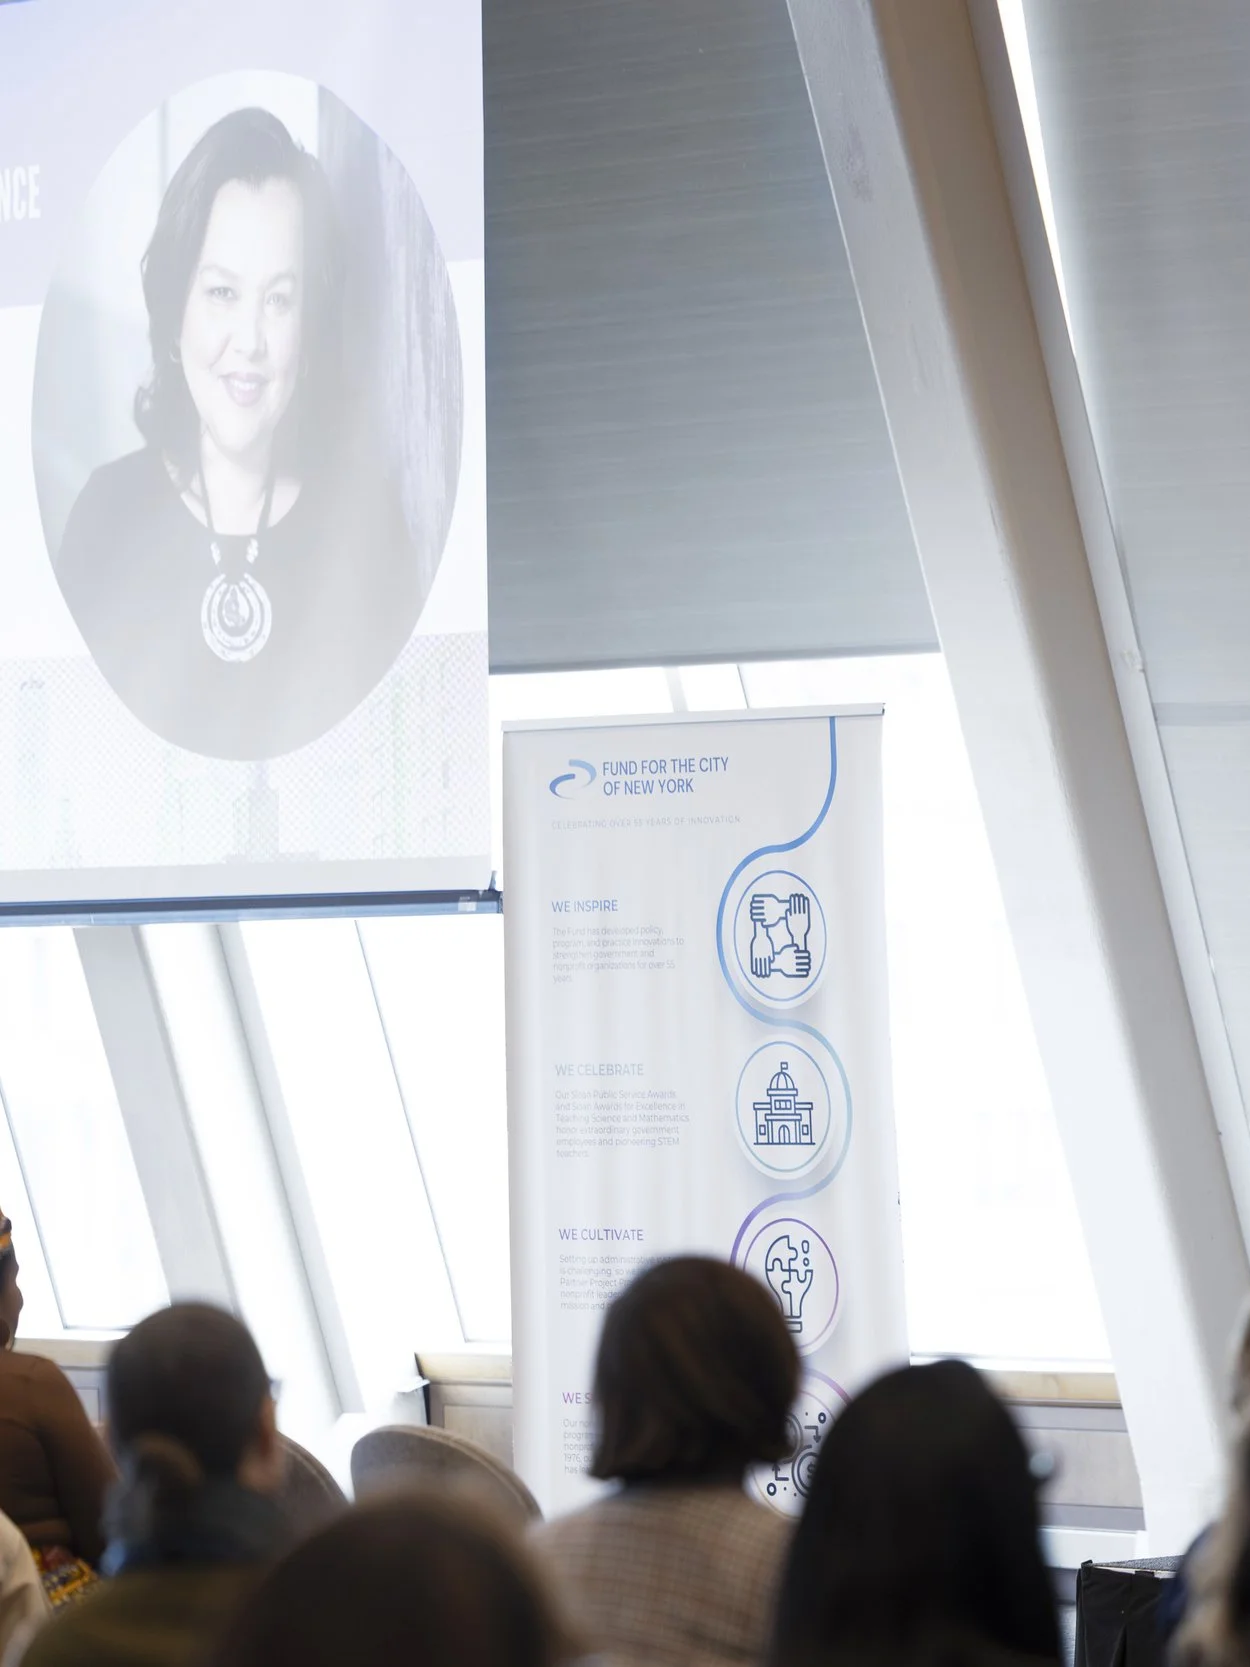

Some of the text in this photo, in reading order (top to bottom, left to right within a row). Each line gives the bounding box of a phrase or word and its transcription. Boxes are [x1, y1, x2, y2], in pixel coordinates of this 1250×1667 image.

[602, 756, 729, 776] FUND FOR THE CITY
[603, 778, 694, 796] OF NEW YORK
[551, 819, 606, 831] CELEBRATING
[609, 818, 632, 829] OVER
[645, 816, 672, 827] YEARS
[673, 816, 686, 826] OF
[687, 814, 741, 826] INNOVATION
[551, 899, 619, 913] WE INSPIRE
[553, 927, 567, 936] The
[601, 926, 639, 937] developed
[676, 936, 685, 946] to
[593, 950, 638, 961] government
[587, 961, 636, 972] organizations
[648, 961, 665, 969] over
[555, 1063, 645, 1076] WE CELEBRATE
[636, 1101, 676, 1111] Excellence
[638, 1113, 690, 1123] Mathematics
[631, 1125, 680, 1136] government
[657, 1136, 680, 1146] STEM
[558, 1229, 645, 1241] WE CULTIVATE
[562, 1392, 582, 1404] WE
